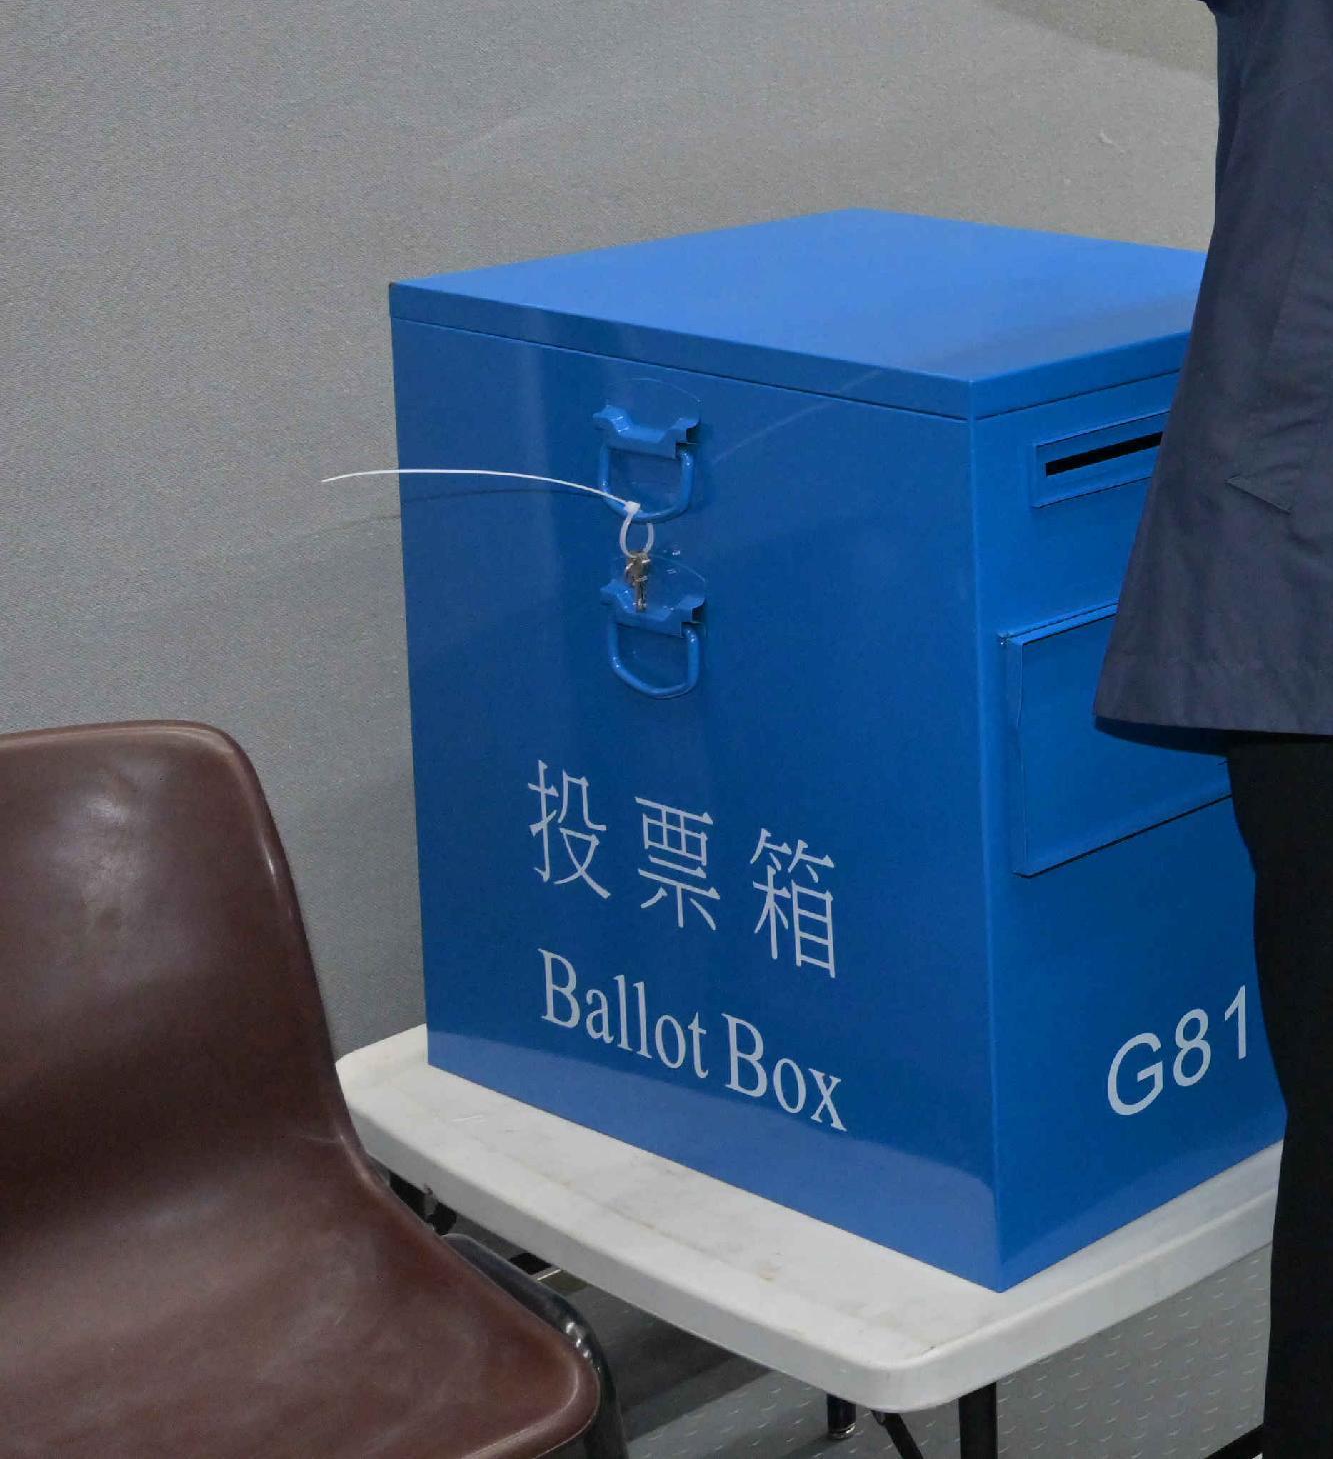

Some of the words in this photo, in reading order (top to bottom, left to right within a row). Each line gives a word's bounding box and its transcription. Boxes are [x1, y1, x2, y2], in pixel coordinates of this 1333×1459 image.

[527, 759, 836, 979] 投票箱
[537, 948, 709, 1079] Ballot
[721, 1013, 848, 1133] Box
[1107, 984, 1247, 1116] G81
